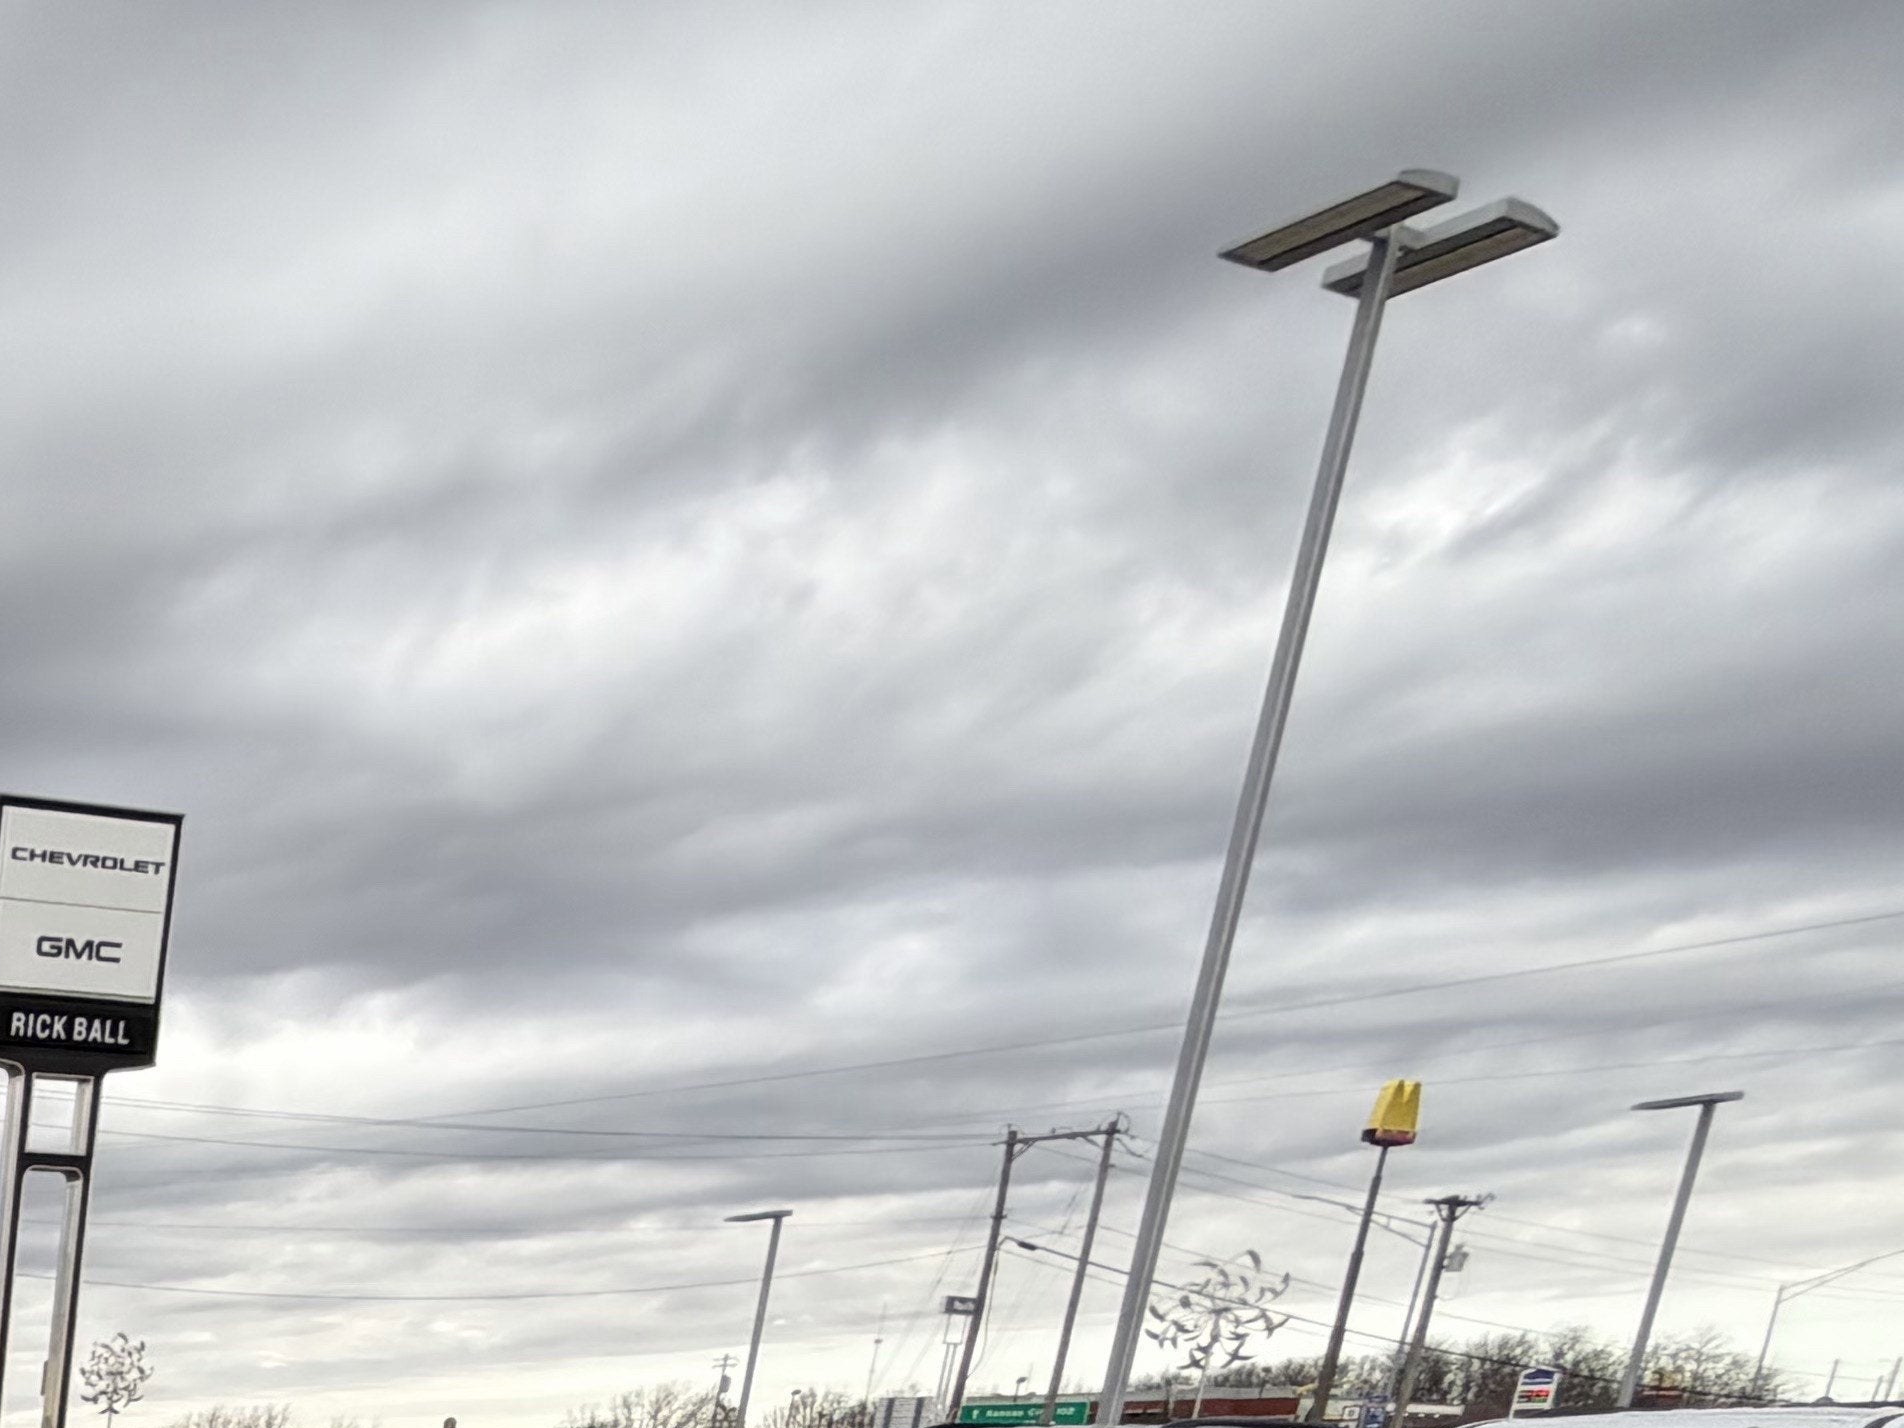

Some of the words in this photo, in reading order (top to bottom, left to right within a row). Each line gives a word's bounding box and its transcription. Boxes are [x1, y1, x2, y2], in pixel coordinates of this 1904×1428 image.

[11, 846, 166, 875] CHEVROLET
[35, 935, 123, 963] GMC
[10, 1011, 68, 1040] RICK
[72, 1018, 131, 1045] BALL
